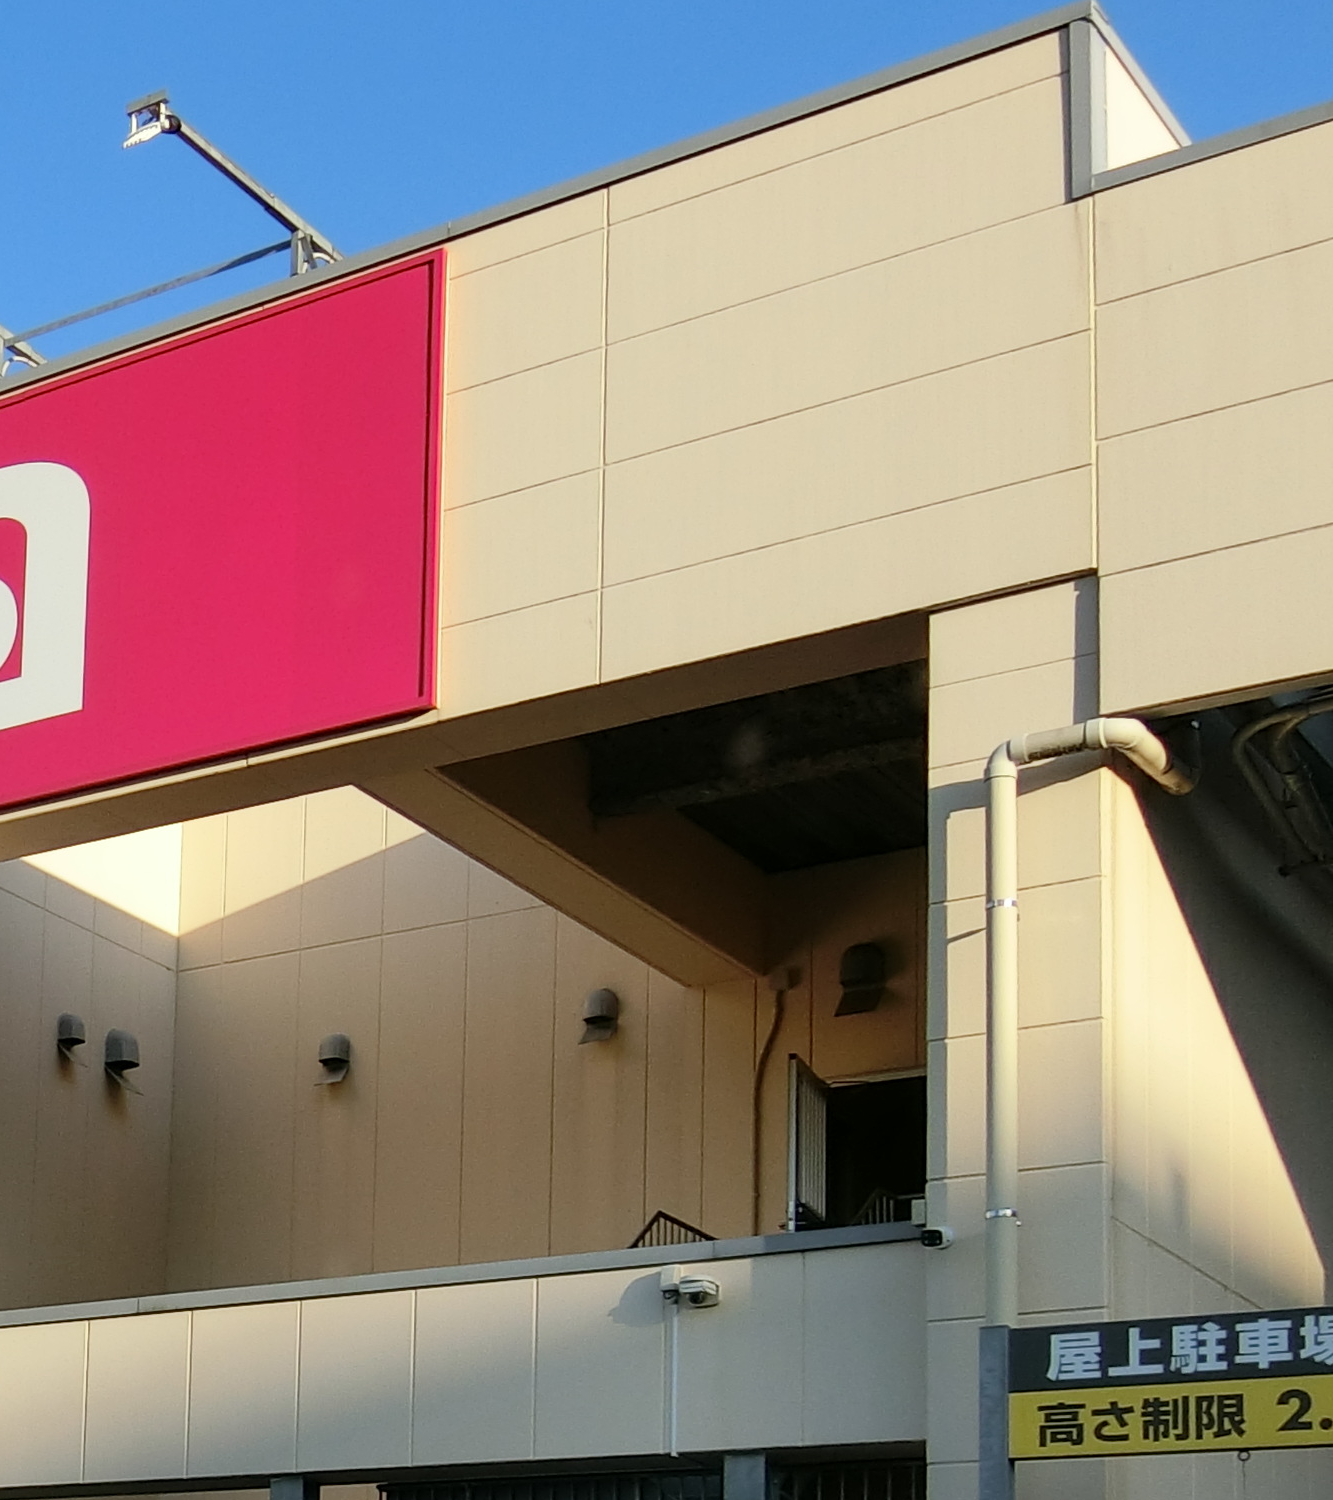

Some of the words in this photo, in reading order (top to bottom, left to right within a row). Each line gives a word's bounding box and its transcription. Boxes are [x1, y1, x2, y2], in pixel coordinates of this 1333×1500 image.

[1045, 1315, 1332, 1382] 屋上駐車場
[1037, 1393, 1246, 1448] 高さ制限
